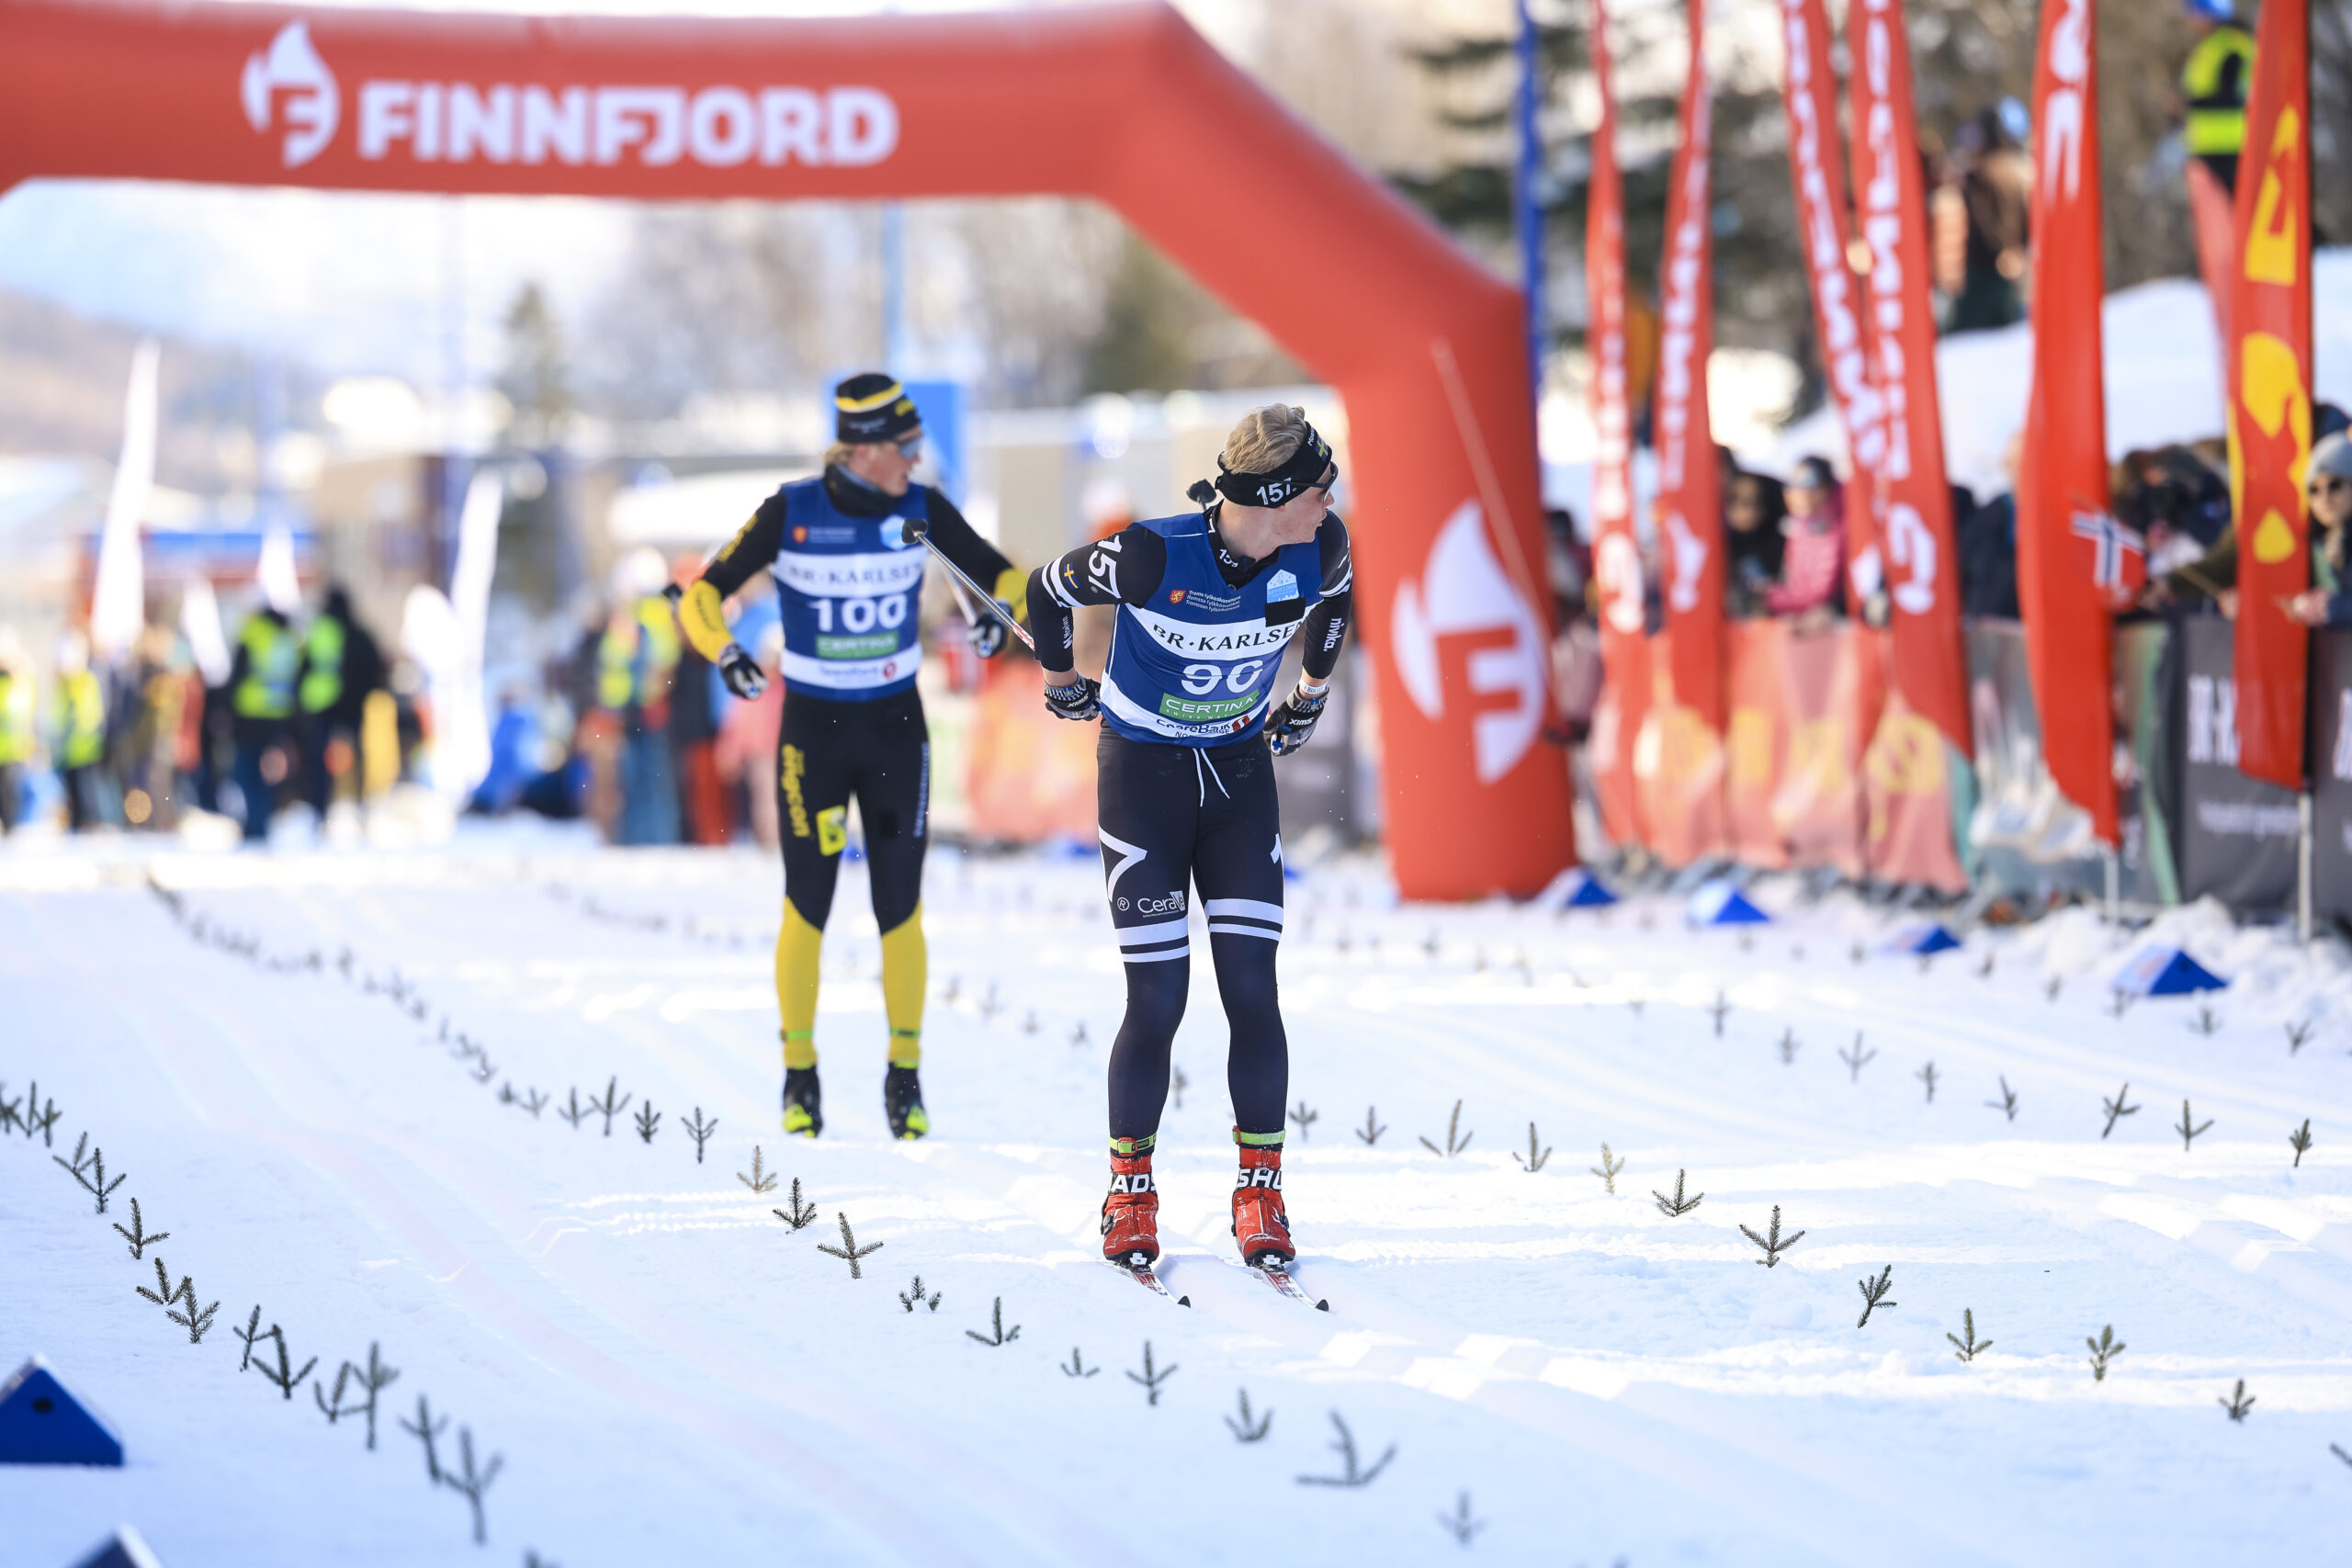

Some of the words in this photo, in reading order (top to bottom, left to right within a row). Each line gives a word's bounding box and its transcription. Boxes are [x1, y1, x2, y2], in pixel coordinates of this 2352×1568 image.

[358, 79, 899, 167] FINNFJORD
[1087, 535, 1122, 599] 157
[808, 593, 908, 634] 100
[1181, 660, 1263, 695] 90
[1165, 696, 1253, 714] CERTINA
